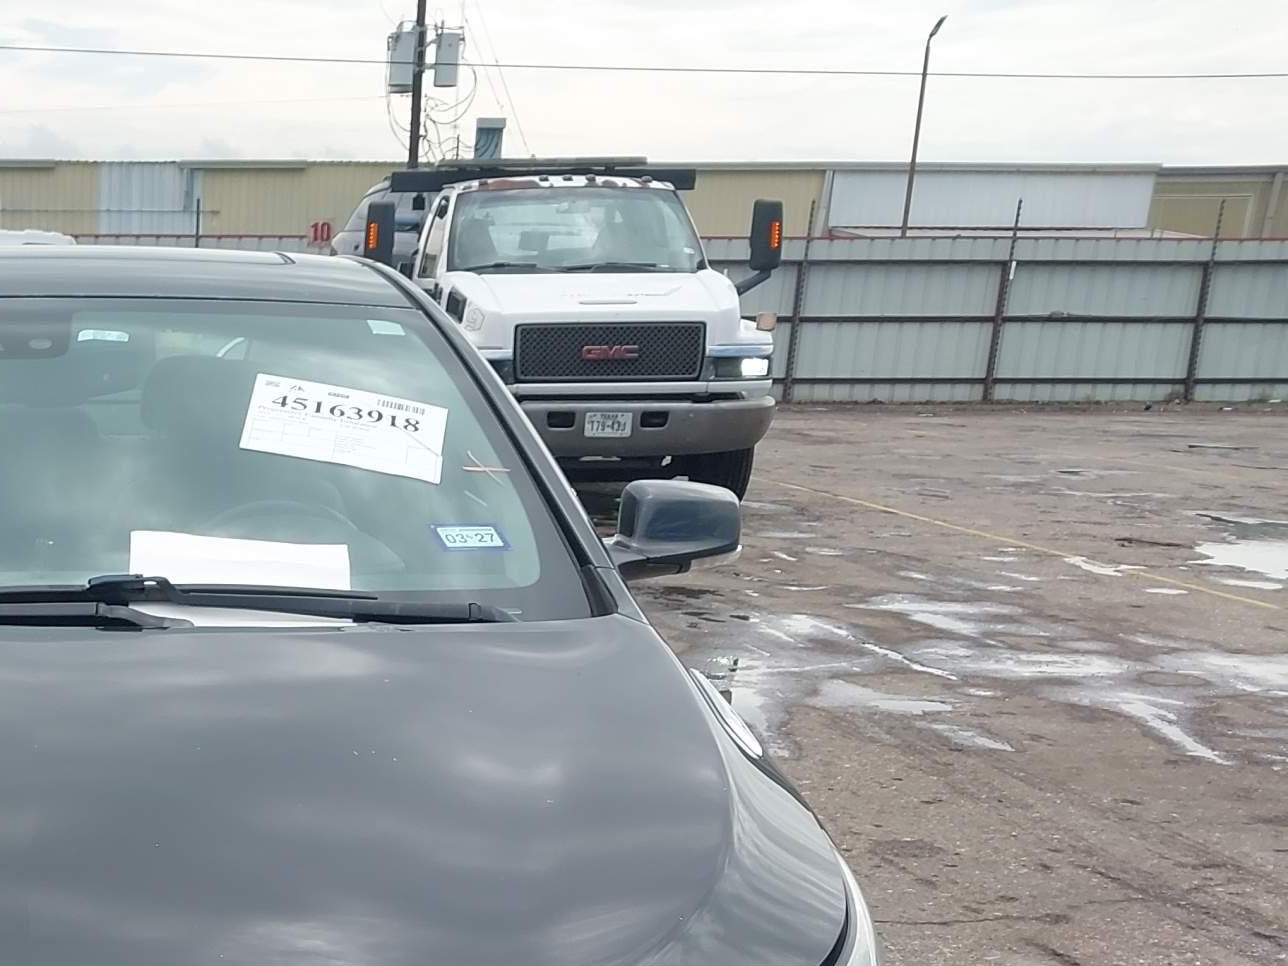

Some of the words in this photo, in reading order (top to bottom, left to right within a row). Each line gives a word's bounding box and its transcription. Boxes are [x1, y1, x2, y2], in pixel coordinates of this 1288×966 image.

[311, 222, 331, 242] 10
[583, 345, 639, 360] GMC
[271, 394, 421, 433] 45163918
